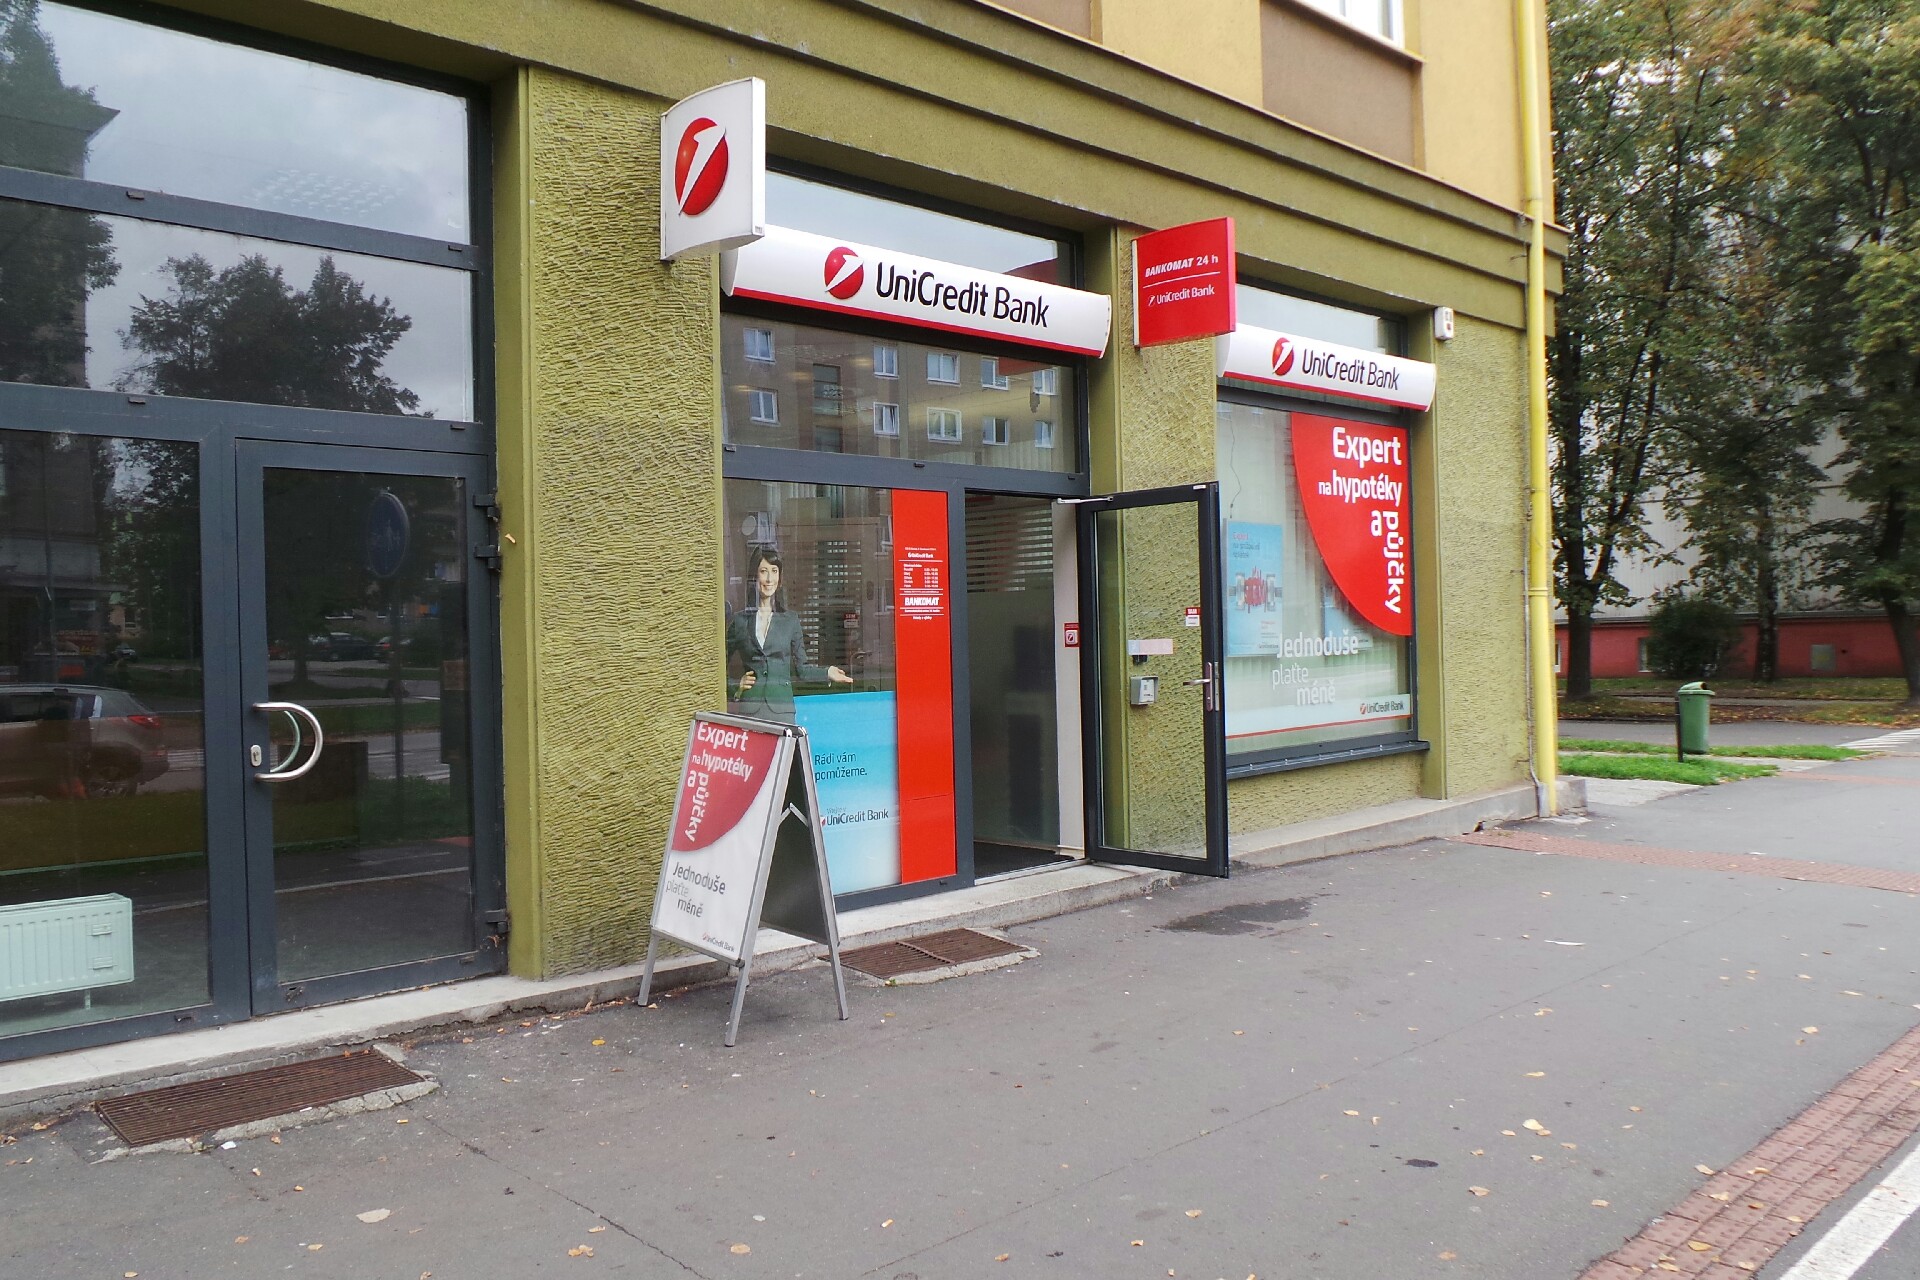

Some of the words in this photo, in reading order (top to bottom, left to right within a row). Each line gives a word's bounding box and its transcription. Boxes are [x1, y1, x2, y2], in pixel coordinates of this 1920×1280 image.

[1145, 258, 1194, 278] BANKOMAT
[1196, 254, 1209, 266] 24
[1211, 254, 1219, 264] h
[876, 262, 988, 317] UniCredit
[992, 287, 1050, 328] Bank
[1156, 287, 1190, 305] UniCredit
[1191, 284, 1215, 298] Bank
[1302, 348, 1365, 385] UniCredit
[1367, 361, 1400, 391] Bank
[1332, 426, 1402, 469] Expert
[1318, 481, 1332, 496] na
[1332, 470, 1402, 507] hypotéky
[1370, 510, 1383, 537] a
[1382, 511, 1405, 614] půjčky
[1276, 629, 1359, 659] Jednoduše
[1272, 663, 1309, 690] plaťte
[1296, 679, 1336, 706] méně
[1367, 701, 1390, 714] UniCredit
[1391, 700, 1404, 711] Bank
[697, 721, 749, 751] Expert
[692, 754, 701, 763] na
[701, 748, 753, 782] hypotéky
[814, 752, 835, 766] Rádi
[836, 751, 857, 763] vám
[687, 770, 698, 788] a
[814, 766, 867, 783] pomůžeme.
[684, 772, 710, 842] půjčky
[826, 811, 865, 826] UniCredit
[867, 808, 889, 821] Bank
[673, 862, 726, 895] Jednoduše
[677, 898, 704, 918] méně
